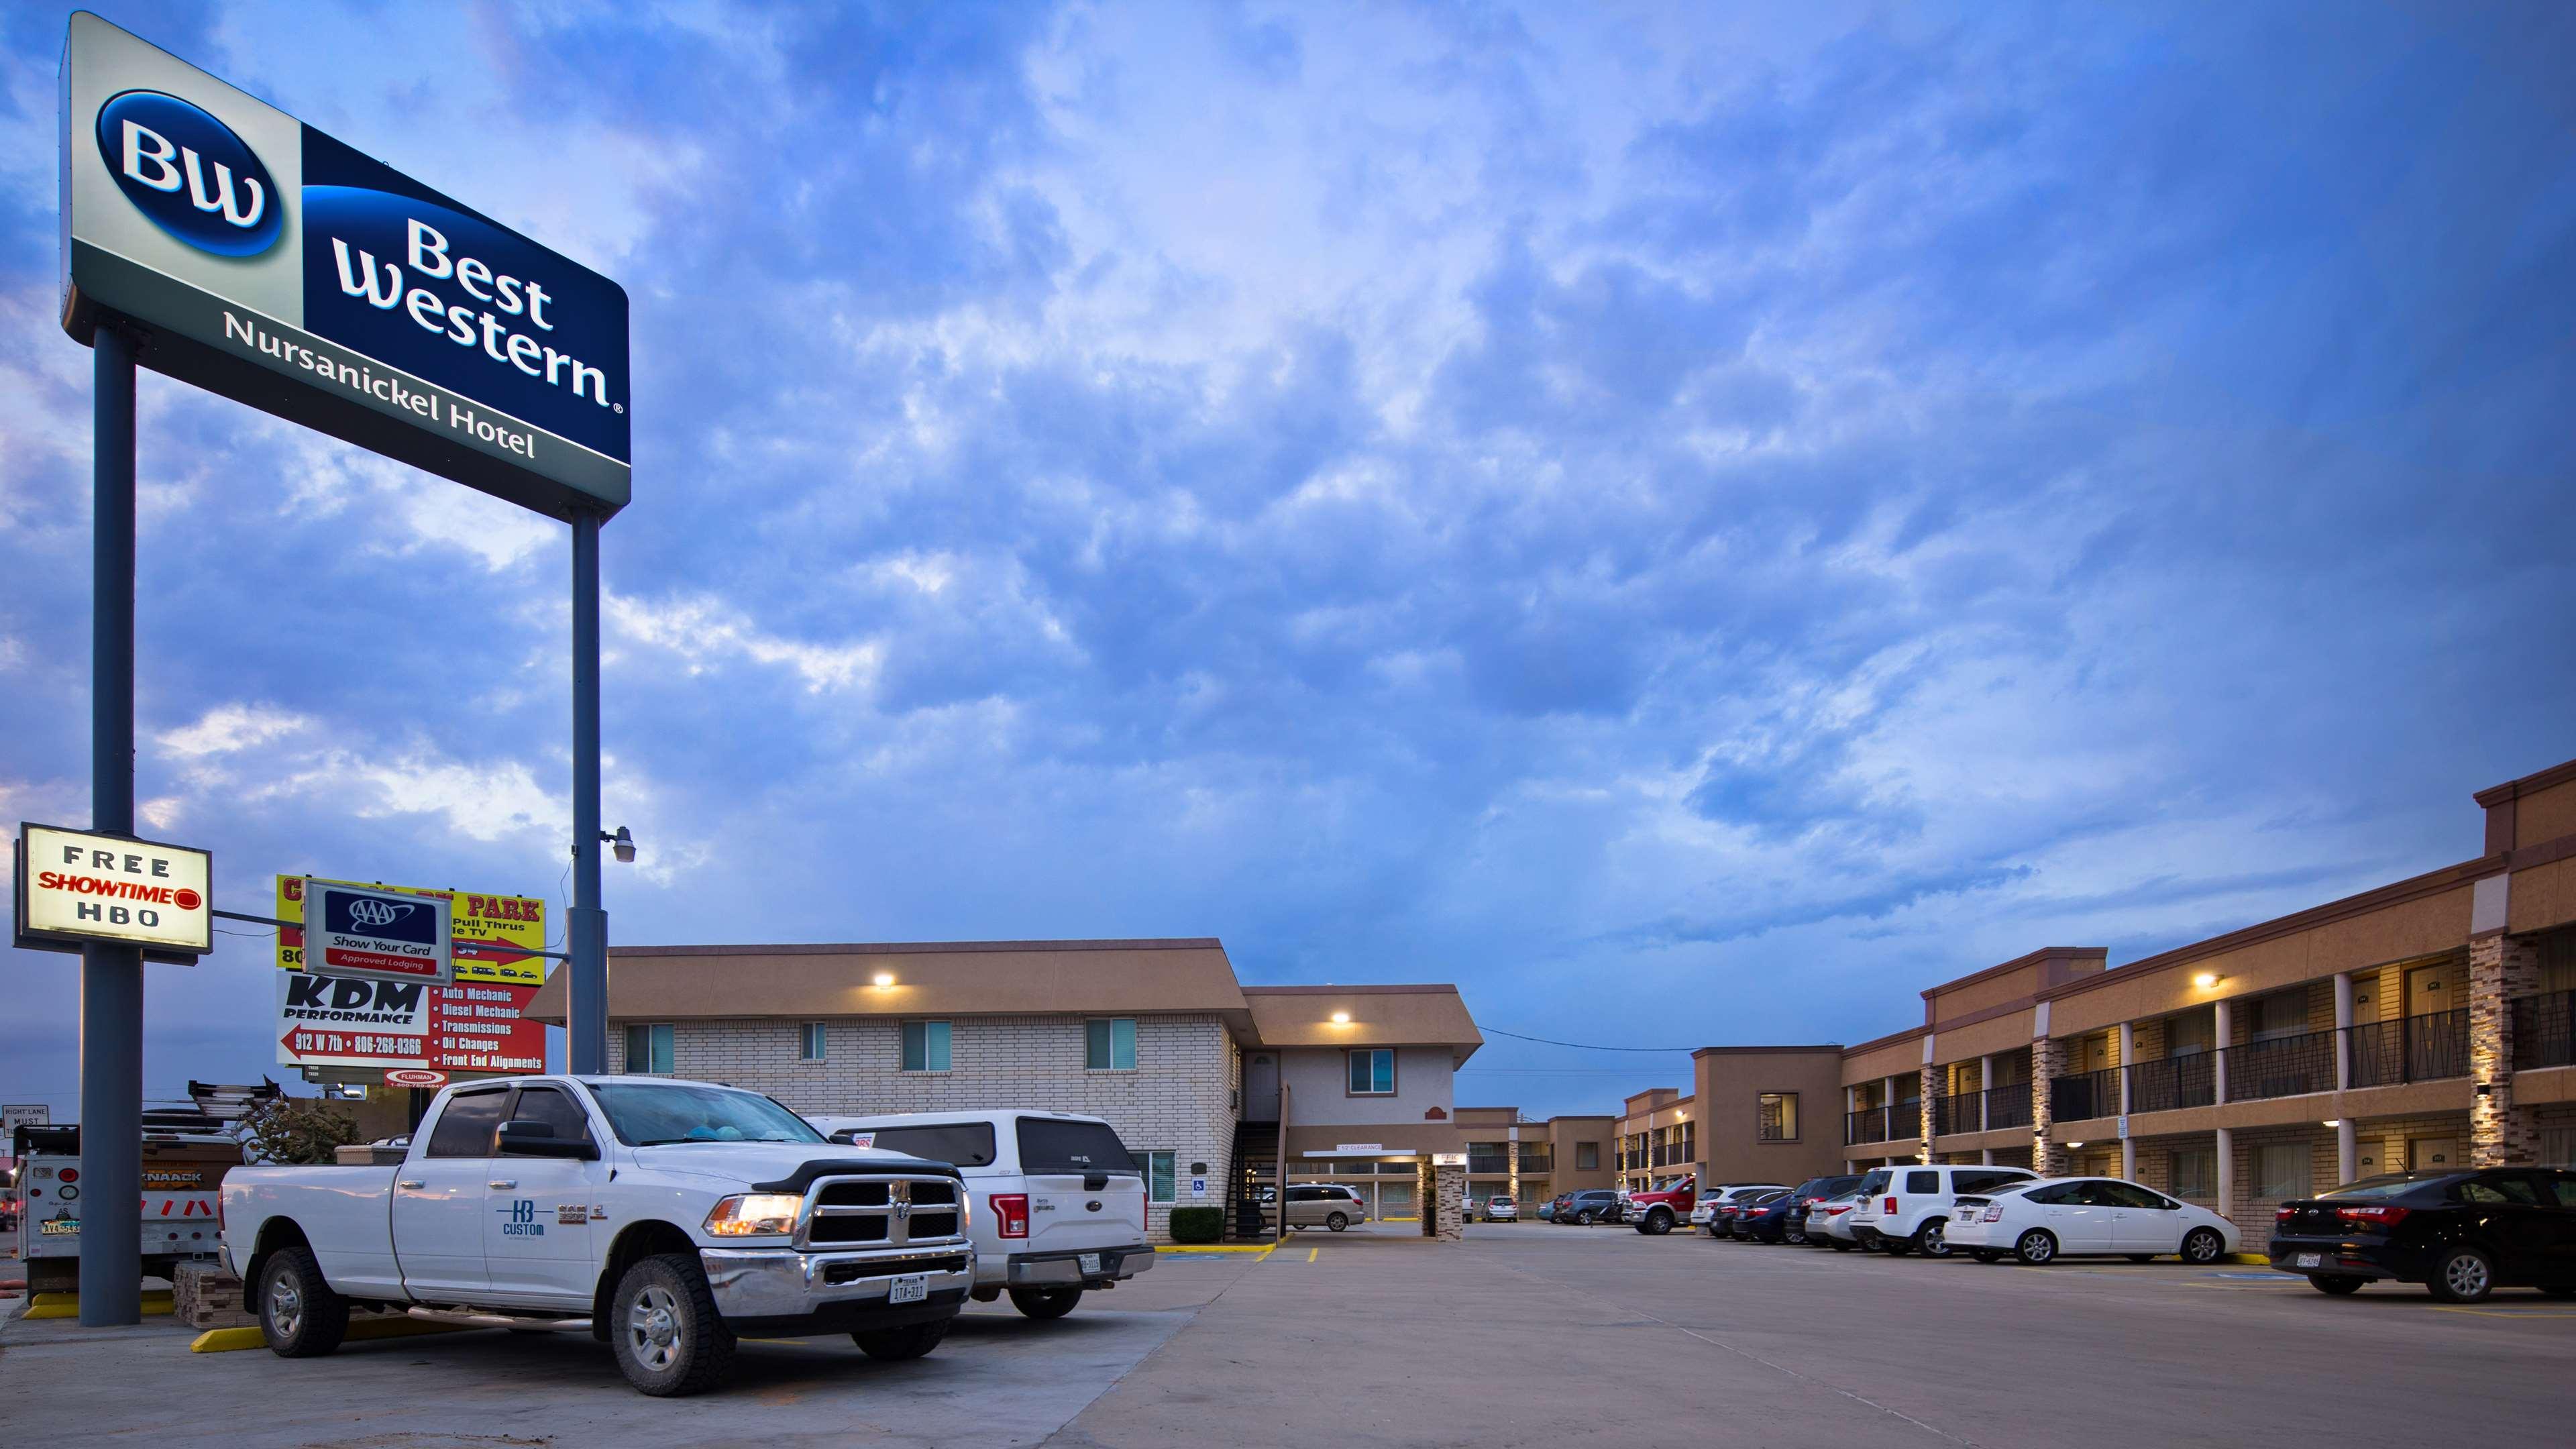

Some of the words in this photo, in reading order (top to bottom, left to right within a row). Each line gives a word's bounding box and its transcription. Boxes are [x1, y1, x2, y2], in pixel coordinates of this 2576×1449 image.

[123, 119, 264, 228] BW
[408, 218, 553, 330] Best
[332, 237, 610, 407] Western
[223, 312, 439, 421] Nursanickel
[451, 404, 535, 460] Hotel
[64, 845, 169, 877] FREE
[38, 871, 174, 904] SHOWTIME
[77, 902, 159, 927] HBO
[353, 900, 392, 924] AAA
[468, 895, 540, 922] PARK
[453, 918, 480, 927] Pull
[484, 921, 525, 931] Thrus
[470, 928, 487, 936] TV
[333, 936, 370, 948] Show
[373, 941, 400, 953] Your
[402, 945, 431, 956] Card
[340, 954, 386, 966] Approved
[388, 959, 424, 970] Lodging
[286, 974, 423, 1012] KDM
[442, 987, 464, 1000] Auto
[467, 988, 512, 1002] Mechanic
[284, 1008, 413, 1024] PERFORMANCE
[442, 1004, 472, 1016] Diesel
[476, 1005, 520, 1019] Mechanic
[442, 1020, 512, 1035] Transmissions
[295, 1033, 312, 1050] 912
[315, 1034, 325, 1051] W
[328, 1035, 343, 1052] 7th
[355, 1036, 421, 1055] 806-268-0366
[442, 1037, 455, 1049] Oil
[459, 1037, 498, 1052] Changes
[442, 1054, 468, 1066] Front
[471, 1055, 487, 1067] End
[490, 1055, 542, 1069] Alignments
[504, 1224, 544, 1236] CUSTOM
